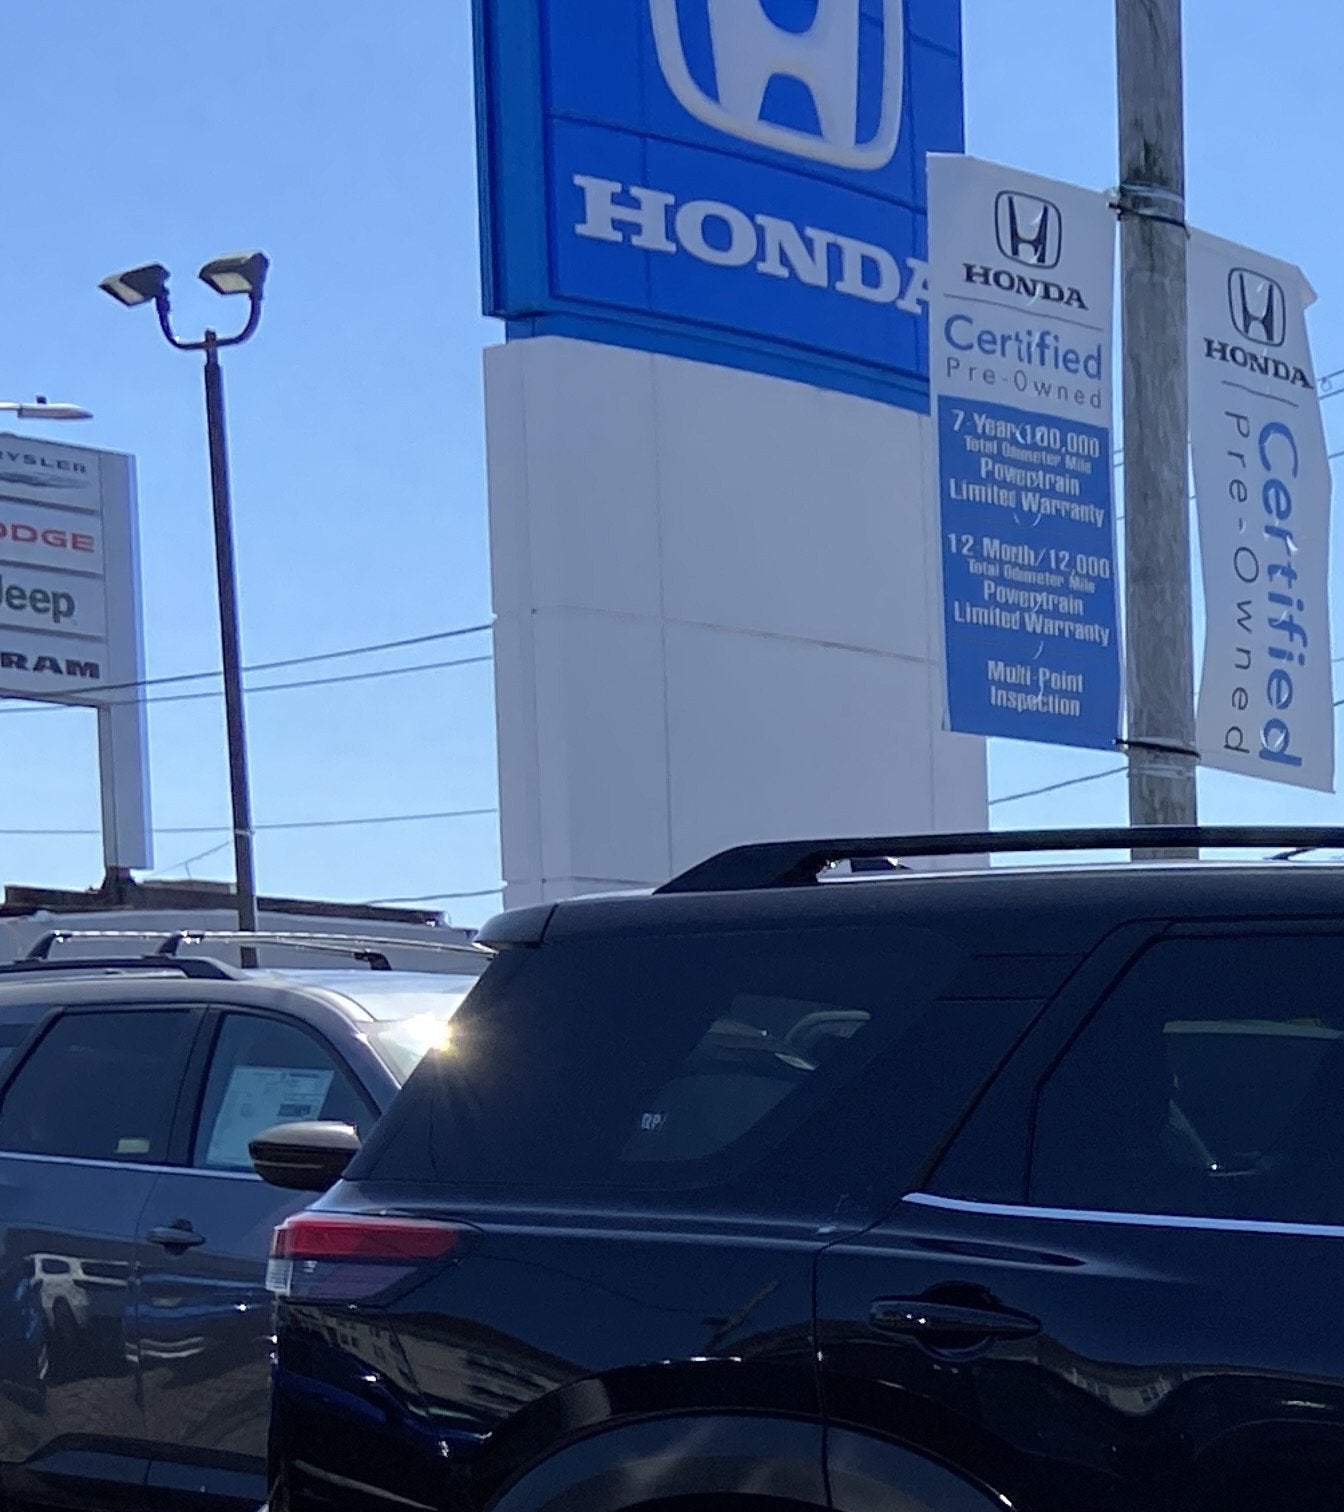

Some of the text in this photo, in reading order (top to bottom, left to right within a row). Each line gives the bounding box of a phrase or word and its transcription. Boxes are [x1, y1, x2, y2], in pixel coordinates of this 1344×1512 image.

[963, 263, 1089, 311] HONDA
[944, 314, 1102, 381] Certified
[1203, 337, 1314, 390] HONDA
[946, 357, 1102, 410] Pre-Owned
[964, 435, 997, 455] Total
[981, 457, 1080, 496] Powertrain
[950, 478, 1104, 528] Limited Warranty
[967, 558, 999, 577] Total
[1224, 411, 1259, 754] Pre-Owned
[984, 580, 1083, 616] Powertrain
[1258, 421, 1308, 767] Certified
[954, 601, 1110, 647] Limited Warranty
[0, 652, 100, 679] RAM
[990, 685, 1081, 717] Inspection
